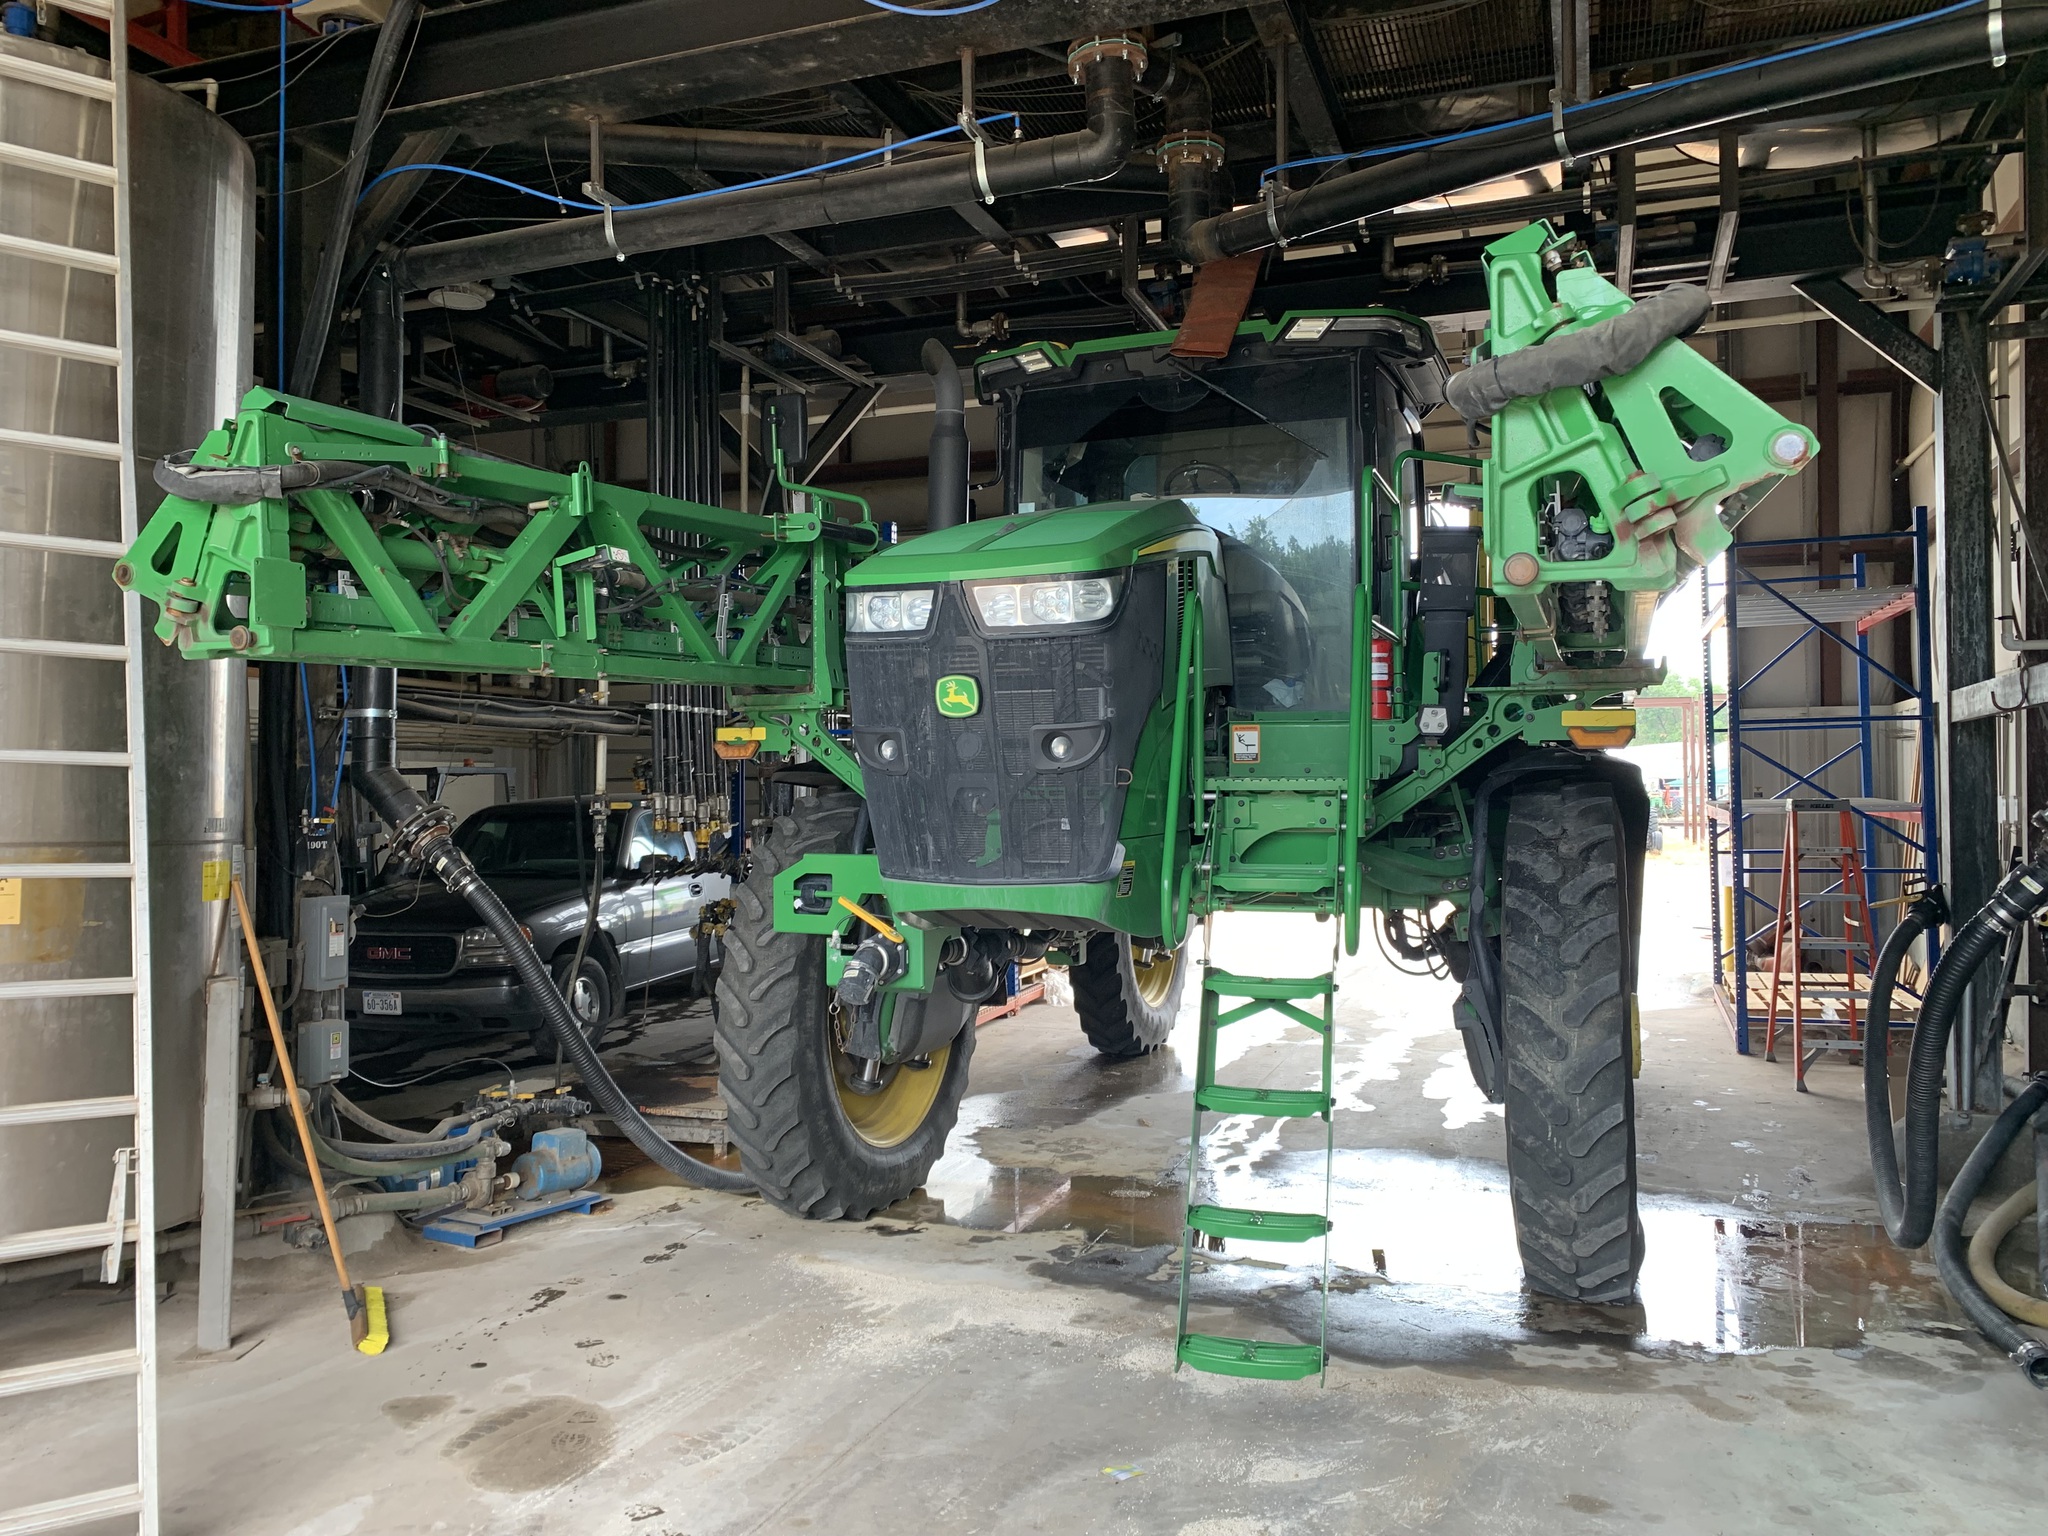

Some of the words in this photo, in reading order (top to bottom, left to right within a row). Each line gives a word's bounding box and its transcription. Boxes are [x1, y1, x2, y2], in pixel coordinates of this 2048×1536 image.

[357, 838, 367, 847] CAT
[367, 947, 411, 959] GMC
[367, 999, 397, 1011] 60-356A
